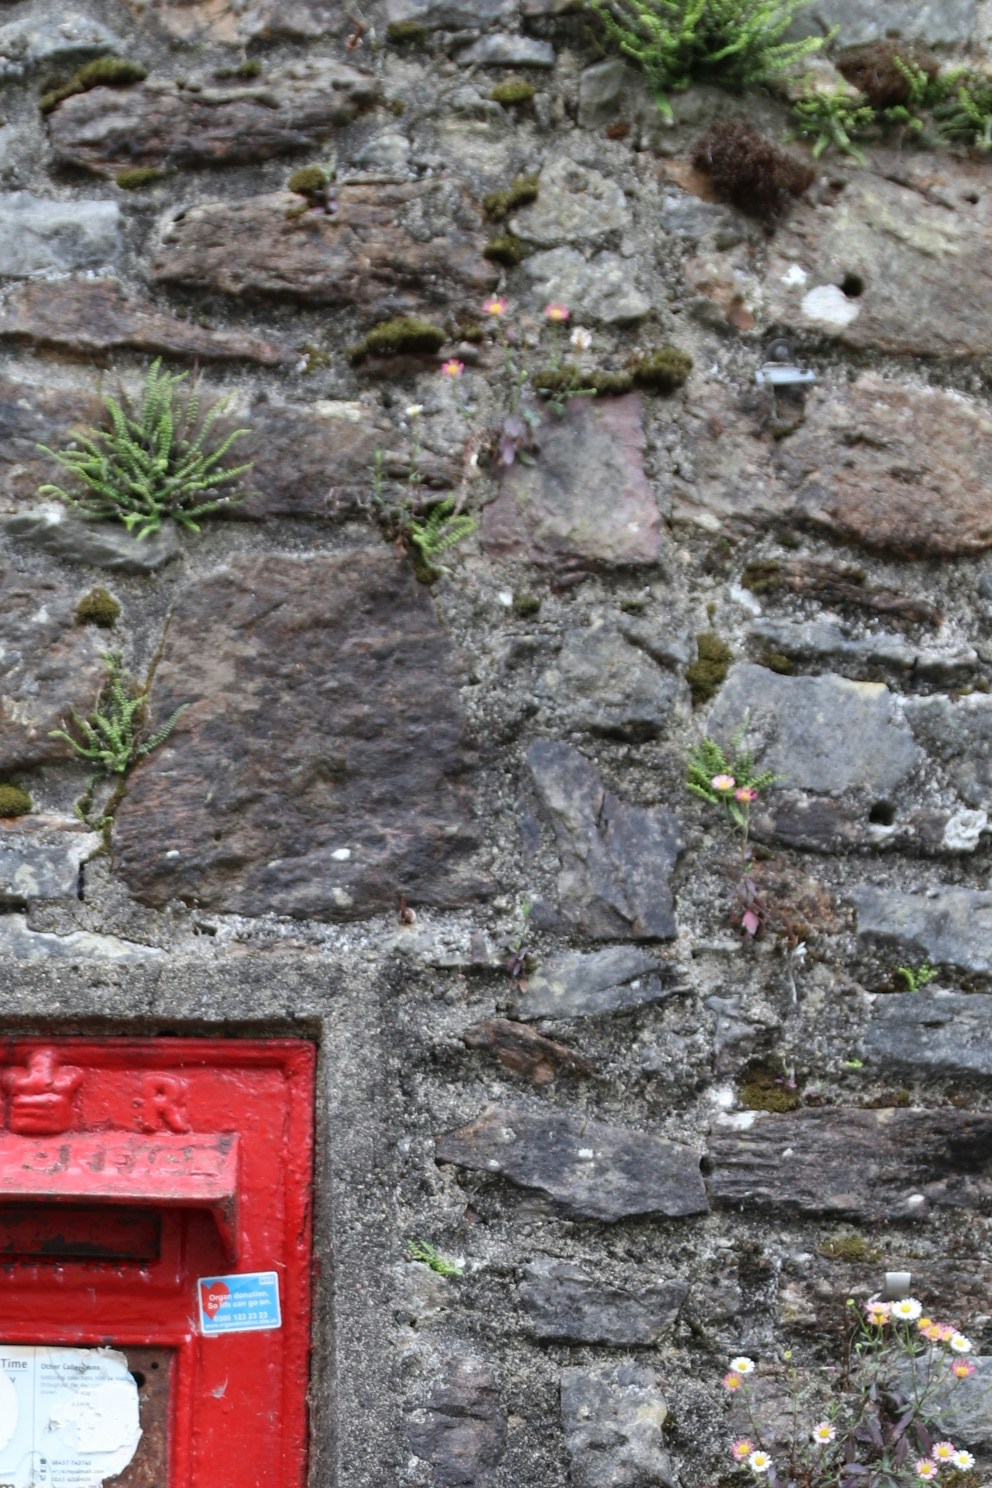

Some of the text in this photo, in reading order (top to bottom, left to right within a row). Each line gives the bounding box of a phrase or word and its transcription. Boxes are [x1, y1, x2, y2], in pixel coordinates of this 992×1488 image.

[132, 1071, 192, 1134] R
[209, 1291, 269, 1302] Organ donation.
[248, 1299, 259, 1308] go
[0, 1358, 28, 1369] Time
[40, 1362, 60, 1370] Other
